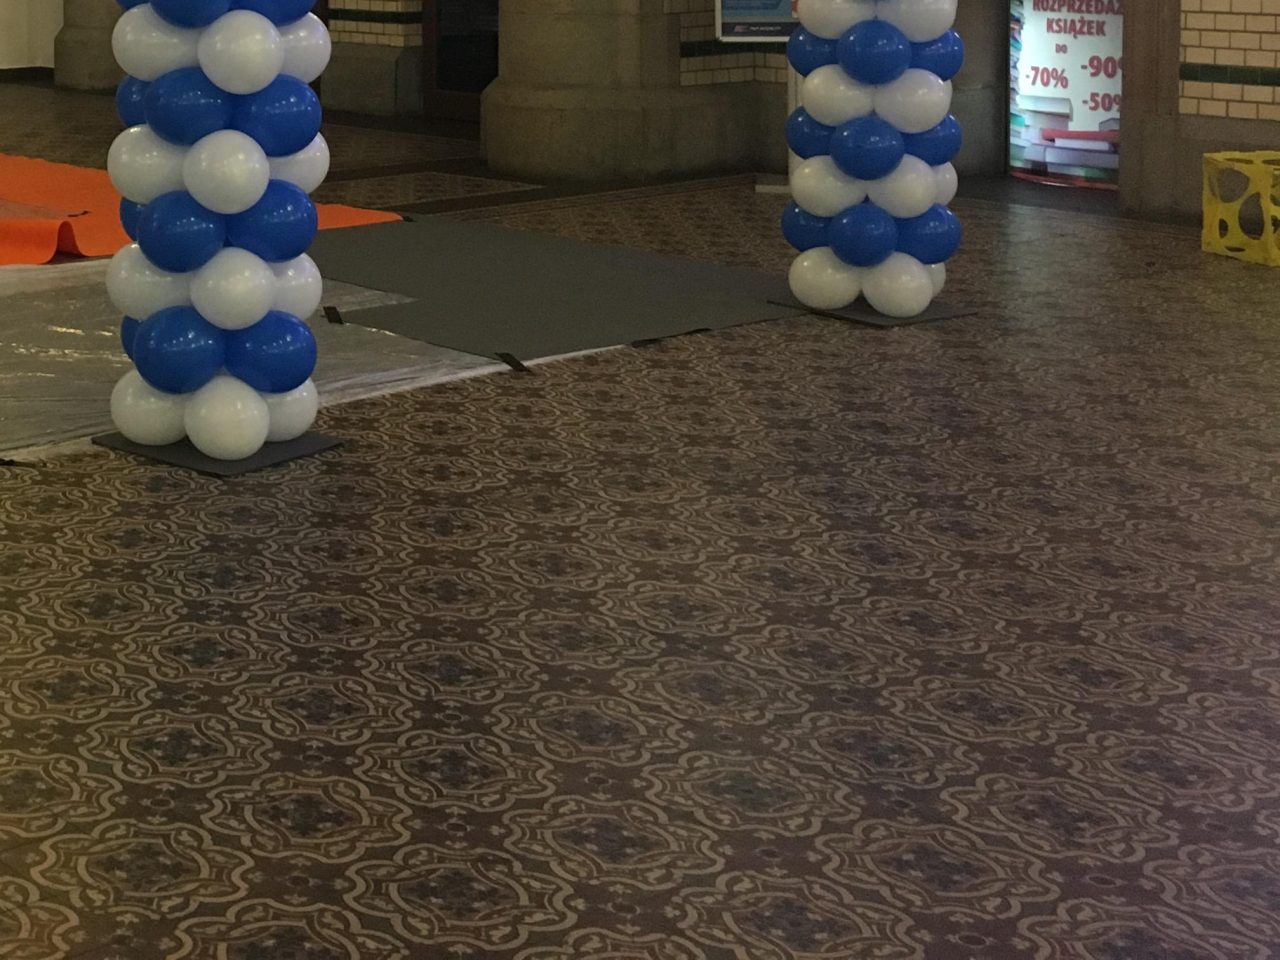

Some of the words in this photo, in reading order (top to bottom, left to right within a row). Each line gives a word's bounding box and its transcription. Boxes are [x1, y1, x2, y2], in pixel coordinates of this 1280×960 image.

[1046, 16, 1106, 39] KSIĄŻEK
[1055, 43, 1068, 54] DO
[1025, 66, 1069, 89] -70%
